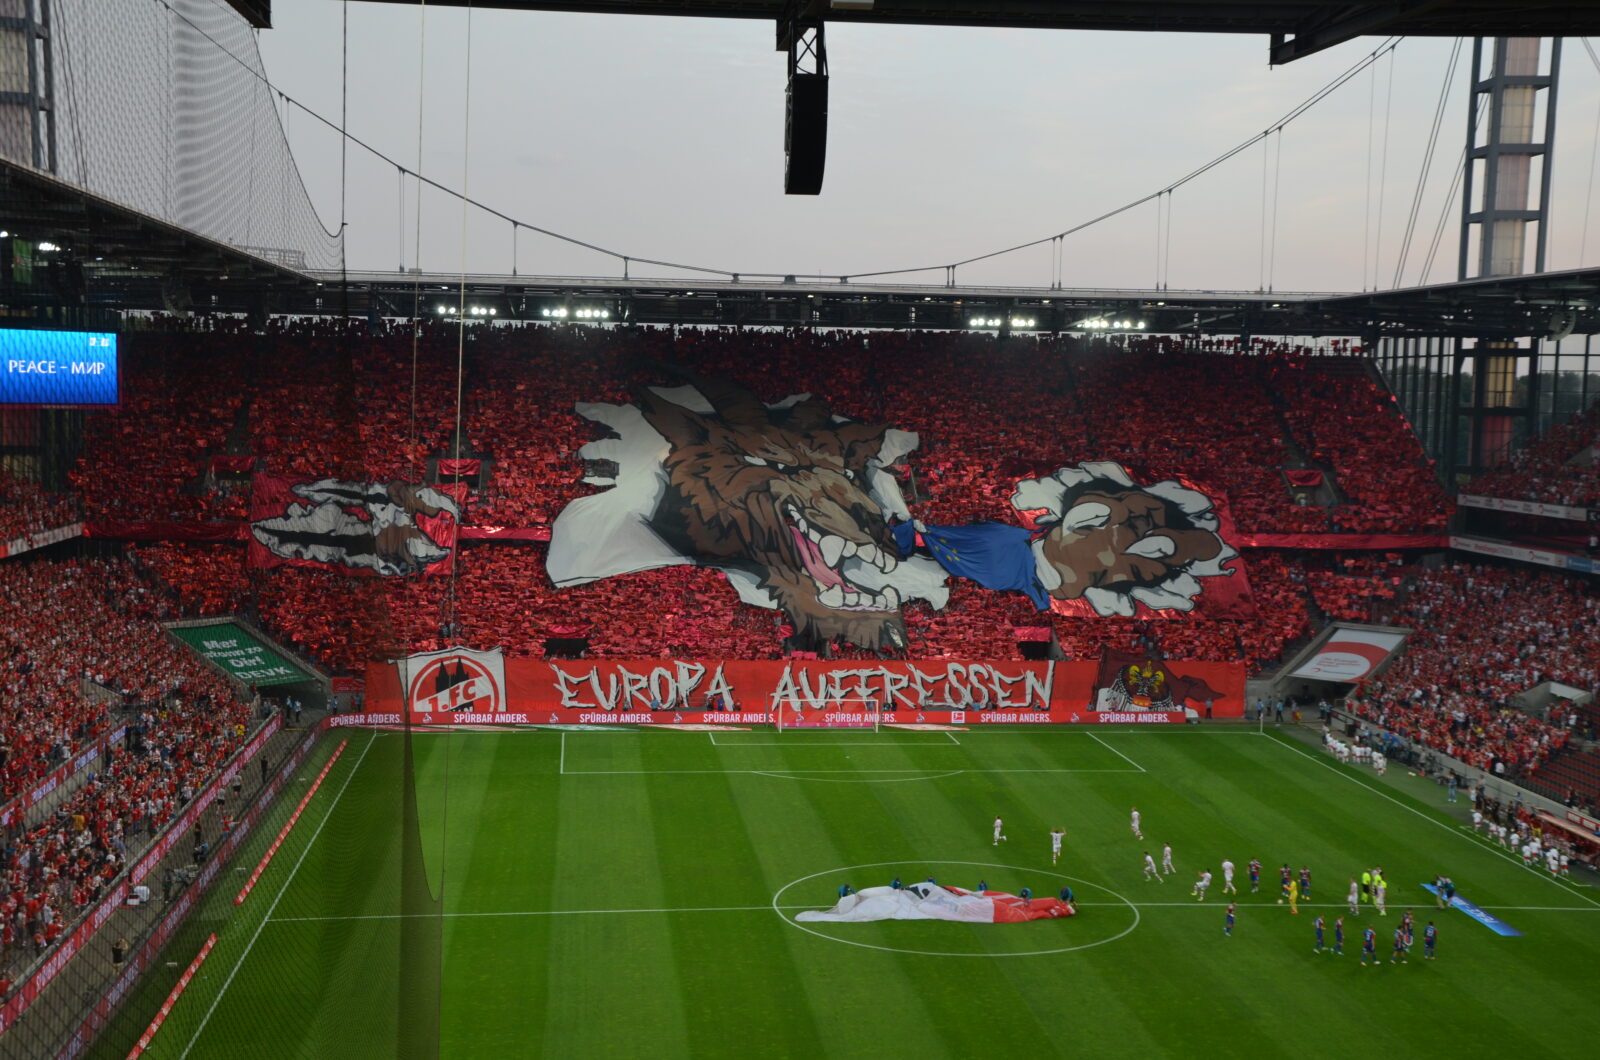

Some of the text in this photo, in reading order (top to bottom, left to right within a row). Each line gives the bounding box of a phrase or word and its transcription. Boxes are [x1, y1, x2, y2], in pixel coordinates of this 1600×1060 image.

[9, 360, 56, 374] PEACE
[71, 361, 105, 374] МИР
[235, 667, 292, 678] DEVK
[550, 660, 1055, 711] EUROPA AUFFRESSEN
[330, 714, 366, 726] SPÜRBAR
[454, 712, 530, 723] SPÜRBAR ANDERS.
[580, 712, 654, 722] SPÜRBAR ANDERS.
[704, 712, 740, 722] SPÜRBAR
[825, 712, 862, 722] SPÜRBAR
[980, 712, 1052, 722] SPÜRBAR ANDERS.
[1100, 712, 1170, 722] SPÜRBAR ANDERS.
